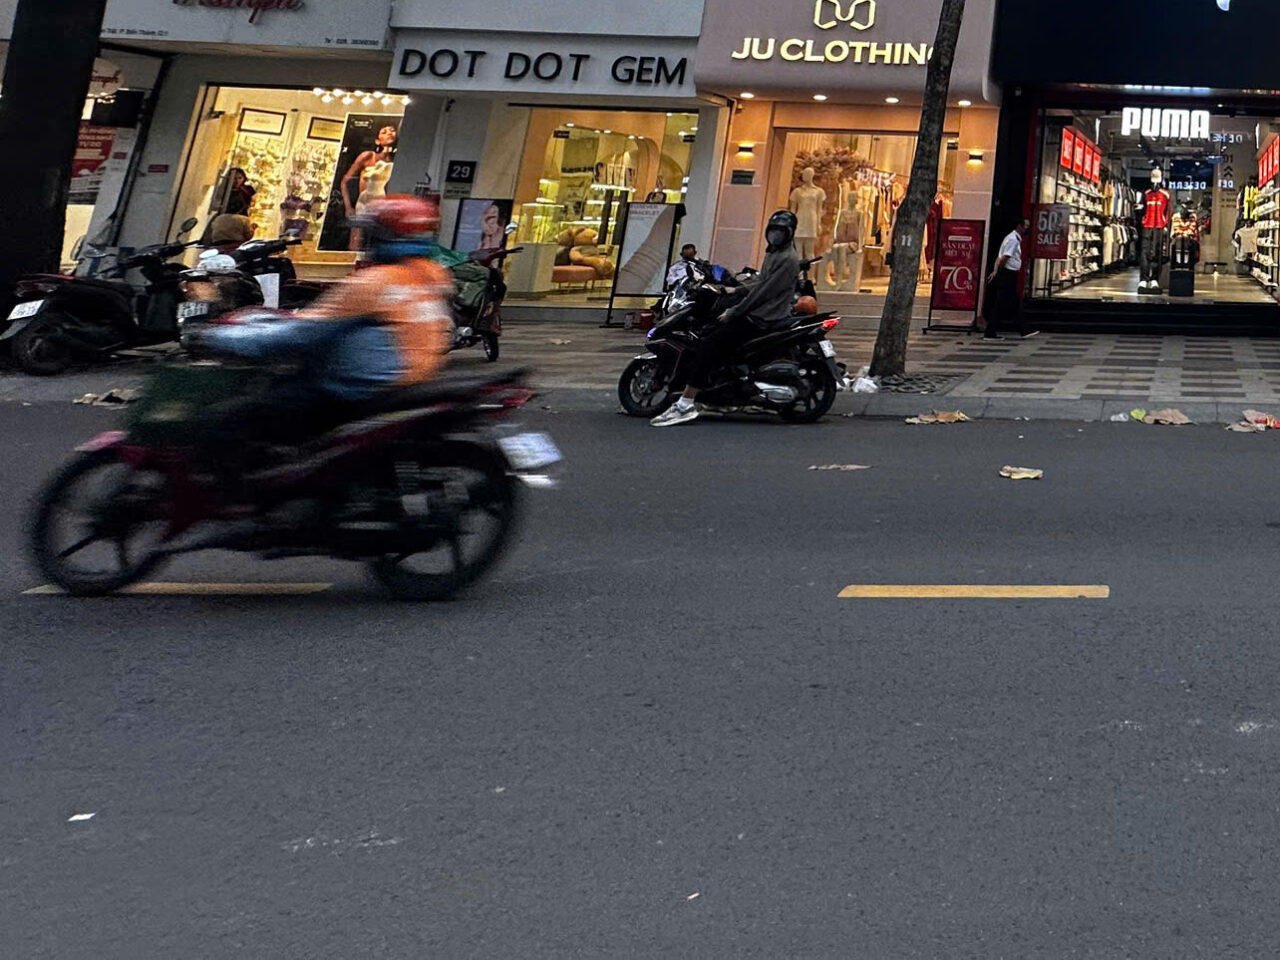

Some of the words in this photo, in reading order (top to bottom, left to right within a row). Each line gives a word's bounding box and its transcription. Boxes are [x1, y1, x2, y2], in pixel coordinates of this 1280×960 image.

[731, 37, 776, 60] JU
[780, 38, 934, 65] CLOTHIN
[399, 48, 487, 79] DOT
[504, 52, 590, 81] DOT
[611, 55, 688, 85] GEM
[1121, 107, 1210, 139] PUMA
[451, 165, 470, 178] 29
[1037, 233, 1061, 245] SALE
